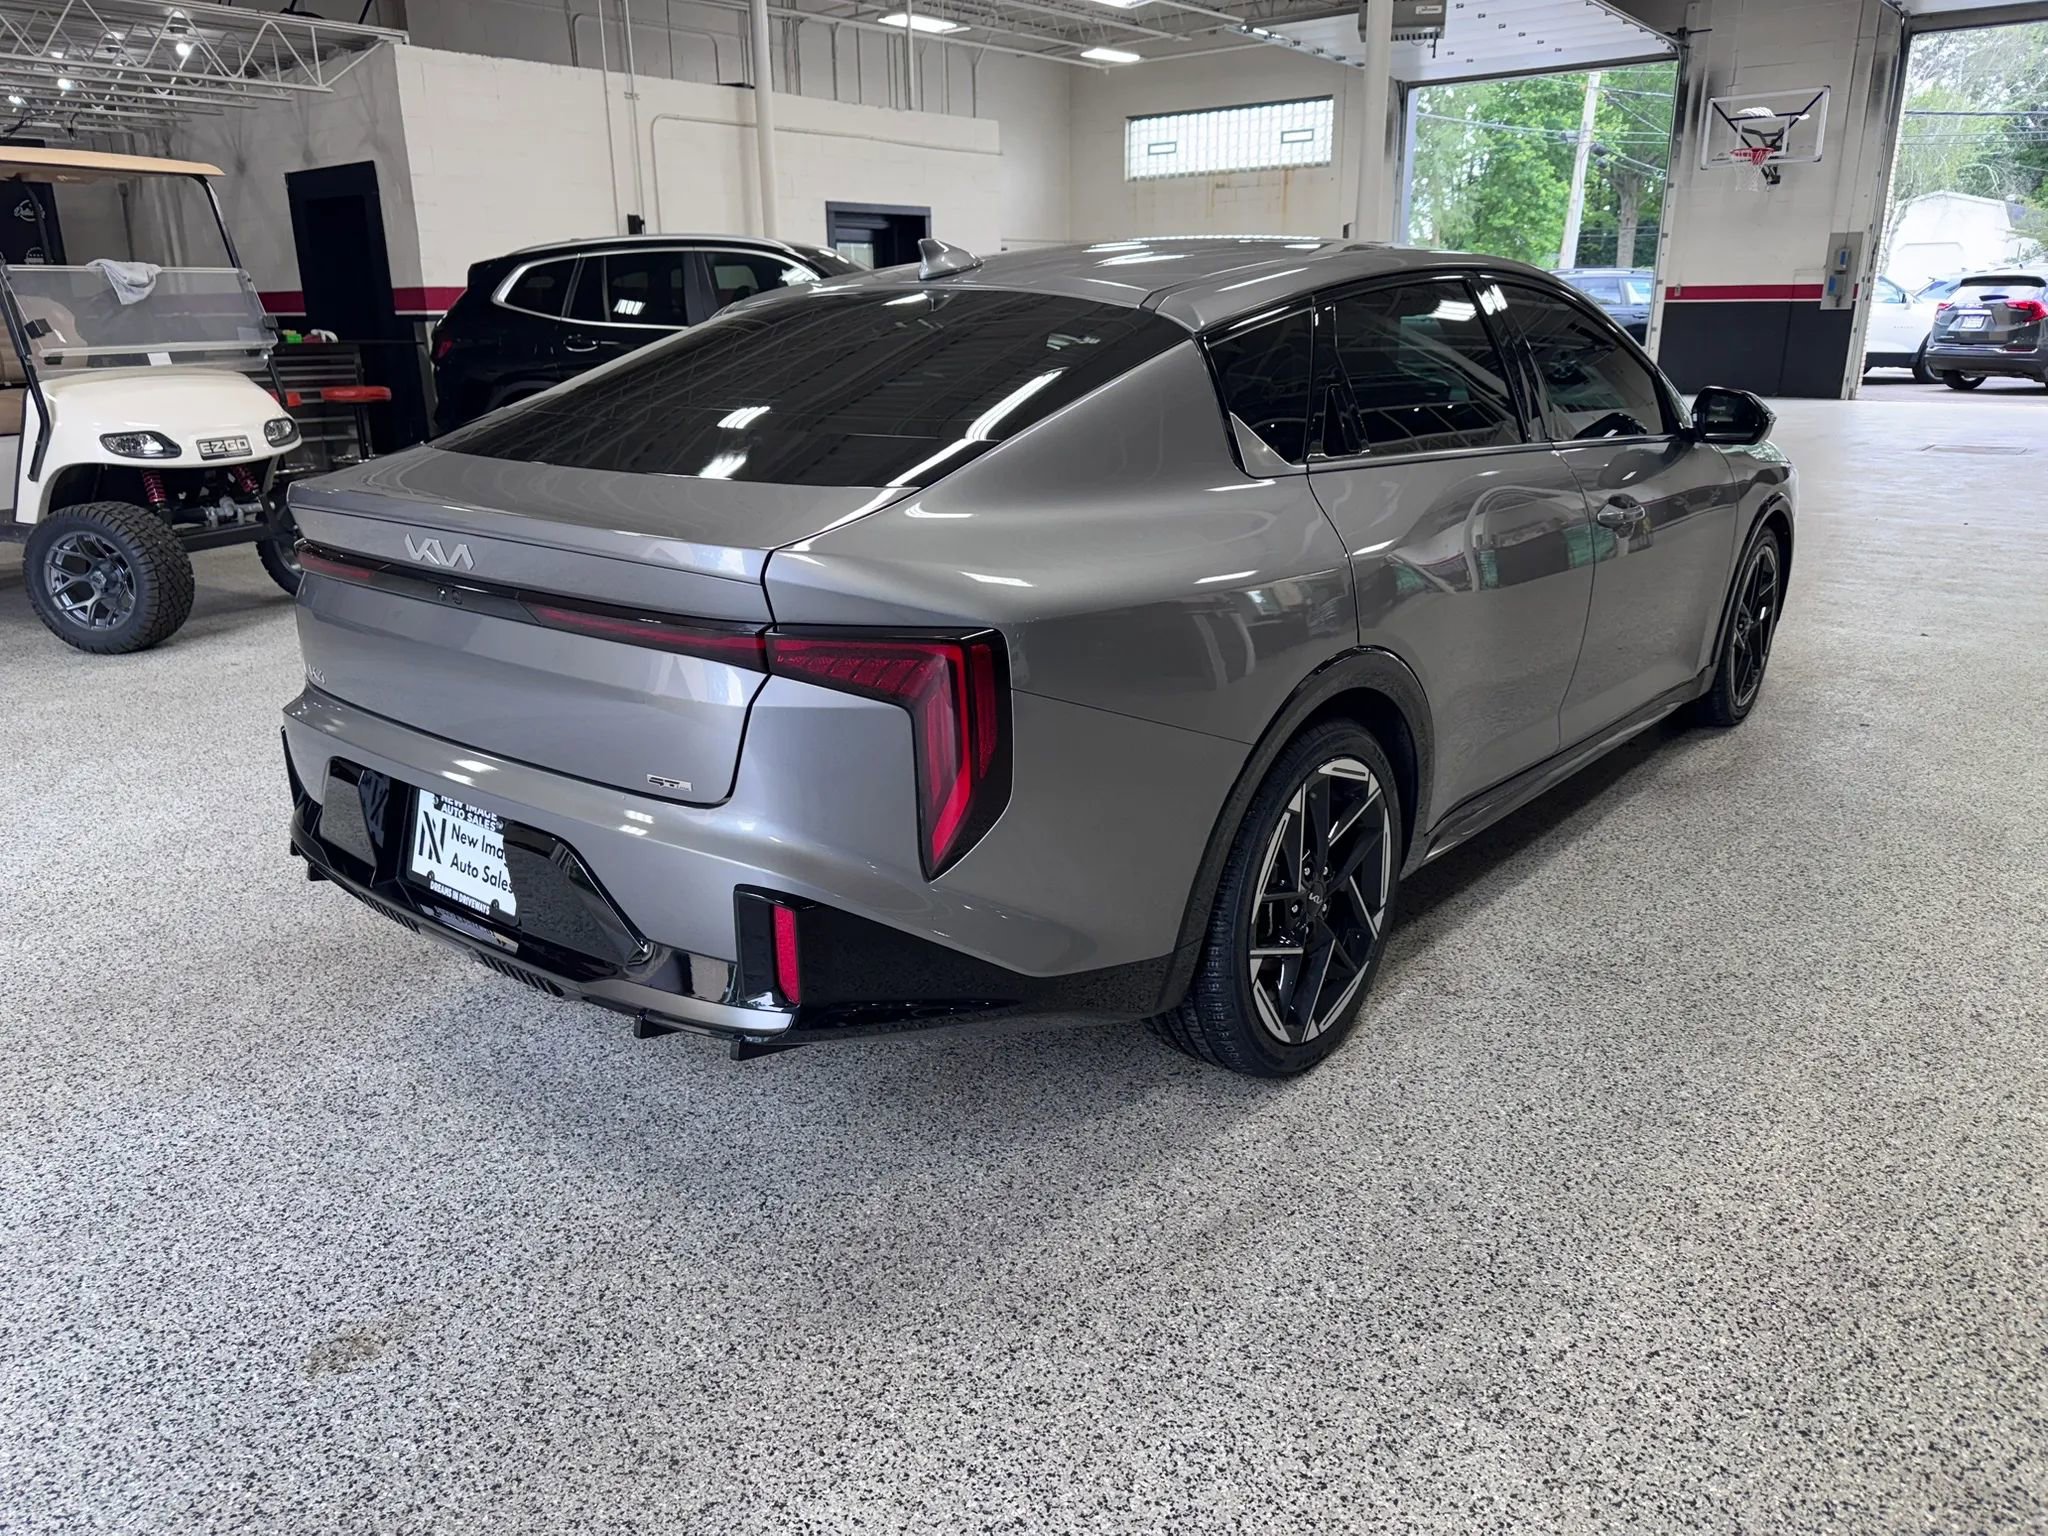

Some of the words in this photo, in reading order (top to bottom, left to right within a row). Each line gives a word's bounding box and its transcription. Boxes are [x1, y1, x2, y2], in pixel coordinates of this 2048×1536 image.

[404, 533, 475, 571] KIA
[441, 803, 465, 821] AUTO
[466, 812, 497, 832] SALES
[451, 822, 479, 849] New
[481, 834, 508, 869] Ima
[450, 852, 479, 879] Auto
[481, 865, 513, 894] Sales
